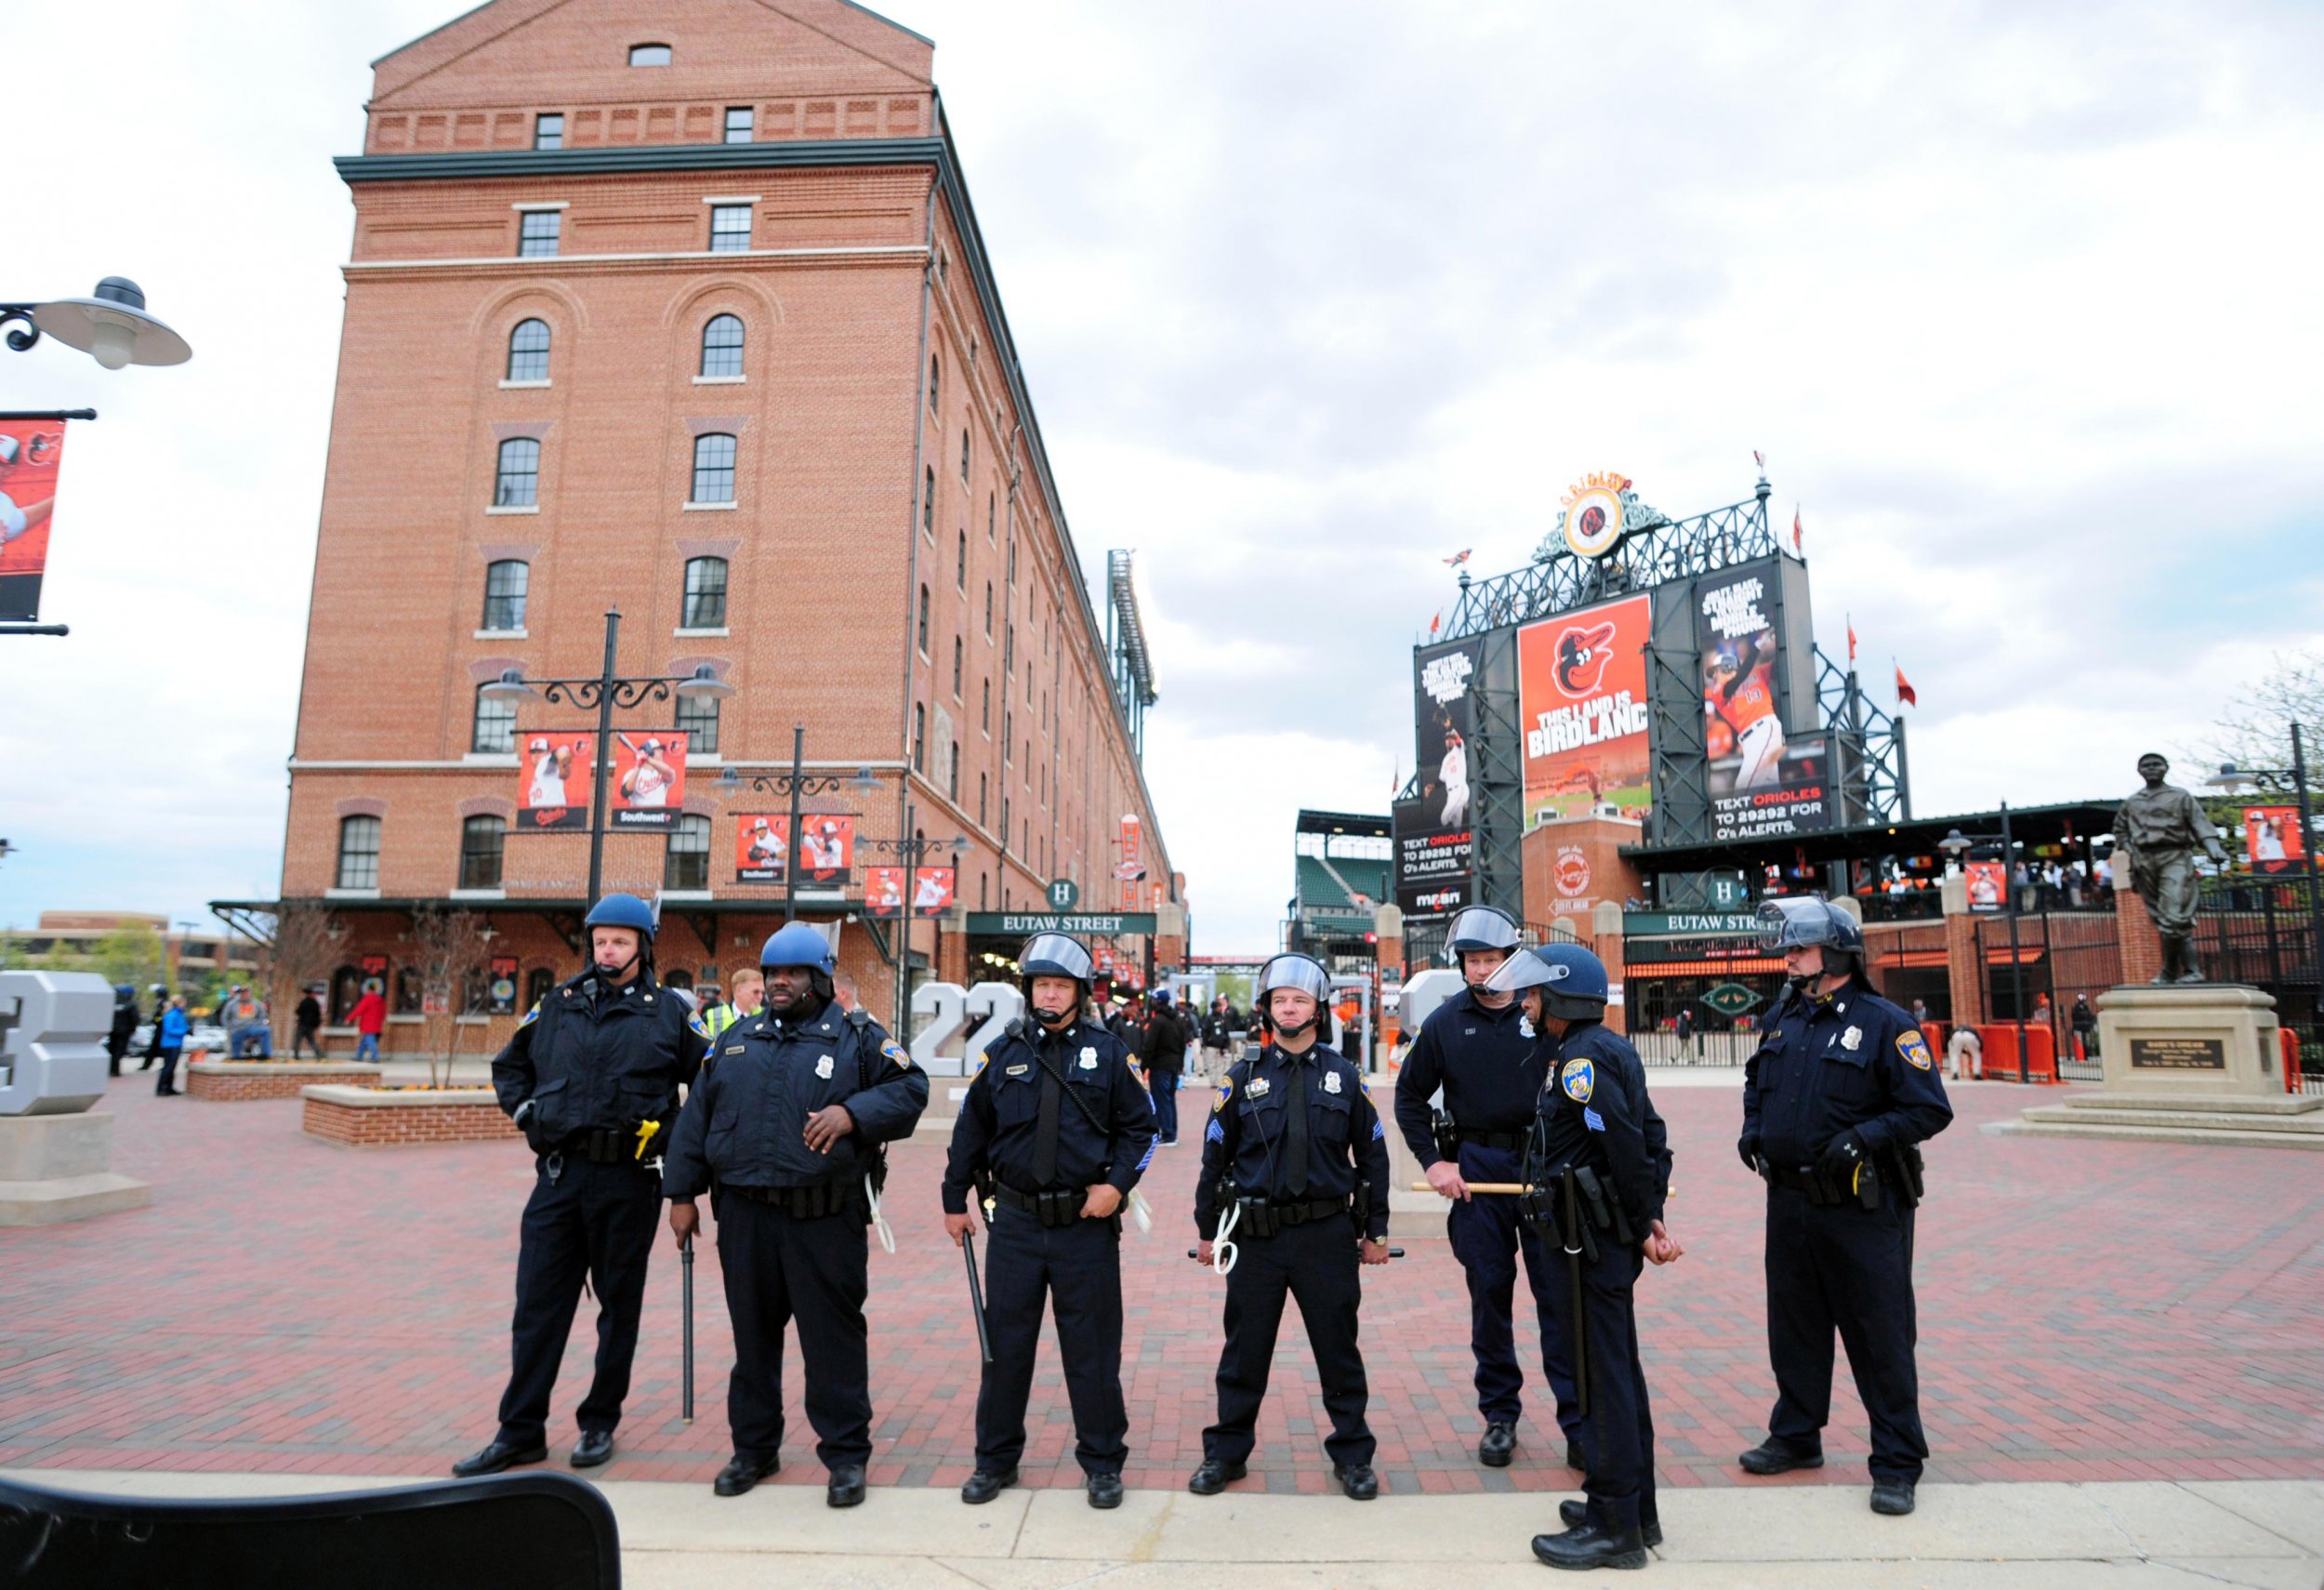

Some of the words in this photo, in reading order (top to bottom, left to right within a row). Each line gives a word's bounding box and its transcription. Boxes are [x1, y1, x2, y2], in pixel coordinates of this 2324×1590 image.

[1537, 706, 1571, 730] THIS
[1573, 695, 1614, 721] LAND
[1615, 689, 1631, 711] IS
[1527, 702, 1648, 760] BIRDLAND
[1714, 796, 1751, 811] TEXT
[1753, 787, 1822, 806] ORIOLES
[620, 811, 665, 823] Southwest
[1715, 813, 1735, 825] TO
[1737, 806, 1787, 824] 29292
[1790, 802, 1823, 817] FOR
[1738, 820, 1797, 838] ALERTS.
[1403, 837, 1429, 850] TEXT
[1430, 831, 1472, 847] ORIOLE
[1403, 851, 1418, 862] TO
[1419, 847, 1453, 860] 29292
[1419, 858, 1459, 872] ALERTS.
[1053, 883, 1070, 901] H
[1716, 881, 1733, 900] H
[1003, 916, 1060, 931] EUTAW
[1063, 916, 1123, 931] STREET
[1668, 914, 1723, 931] EUTAW
[910, 981, 1024, 1077] 22
